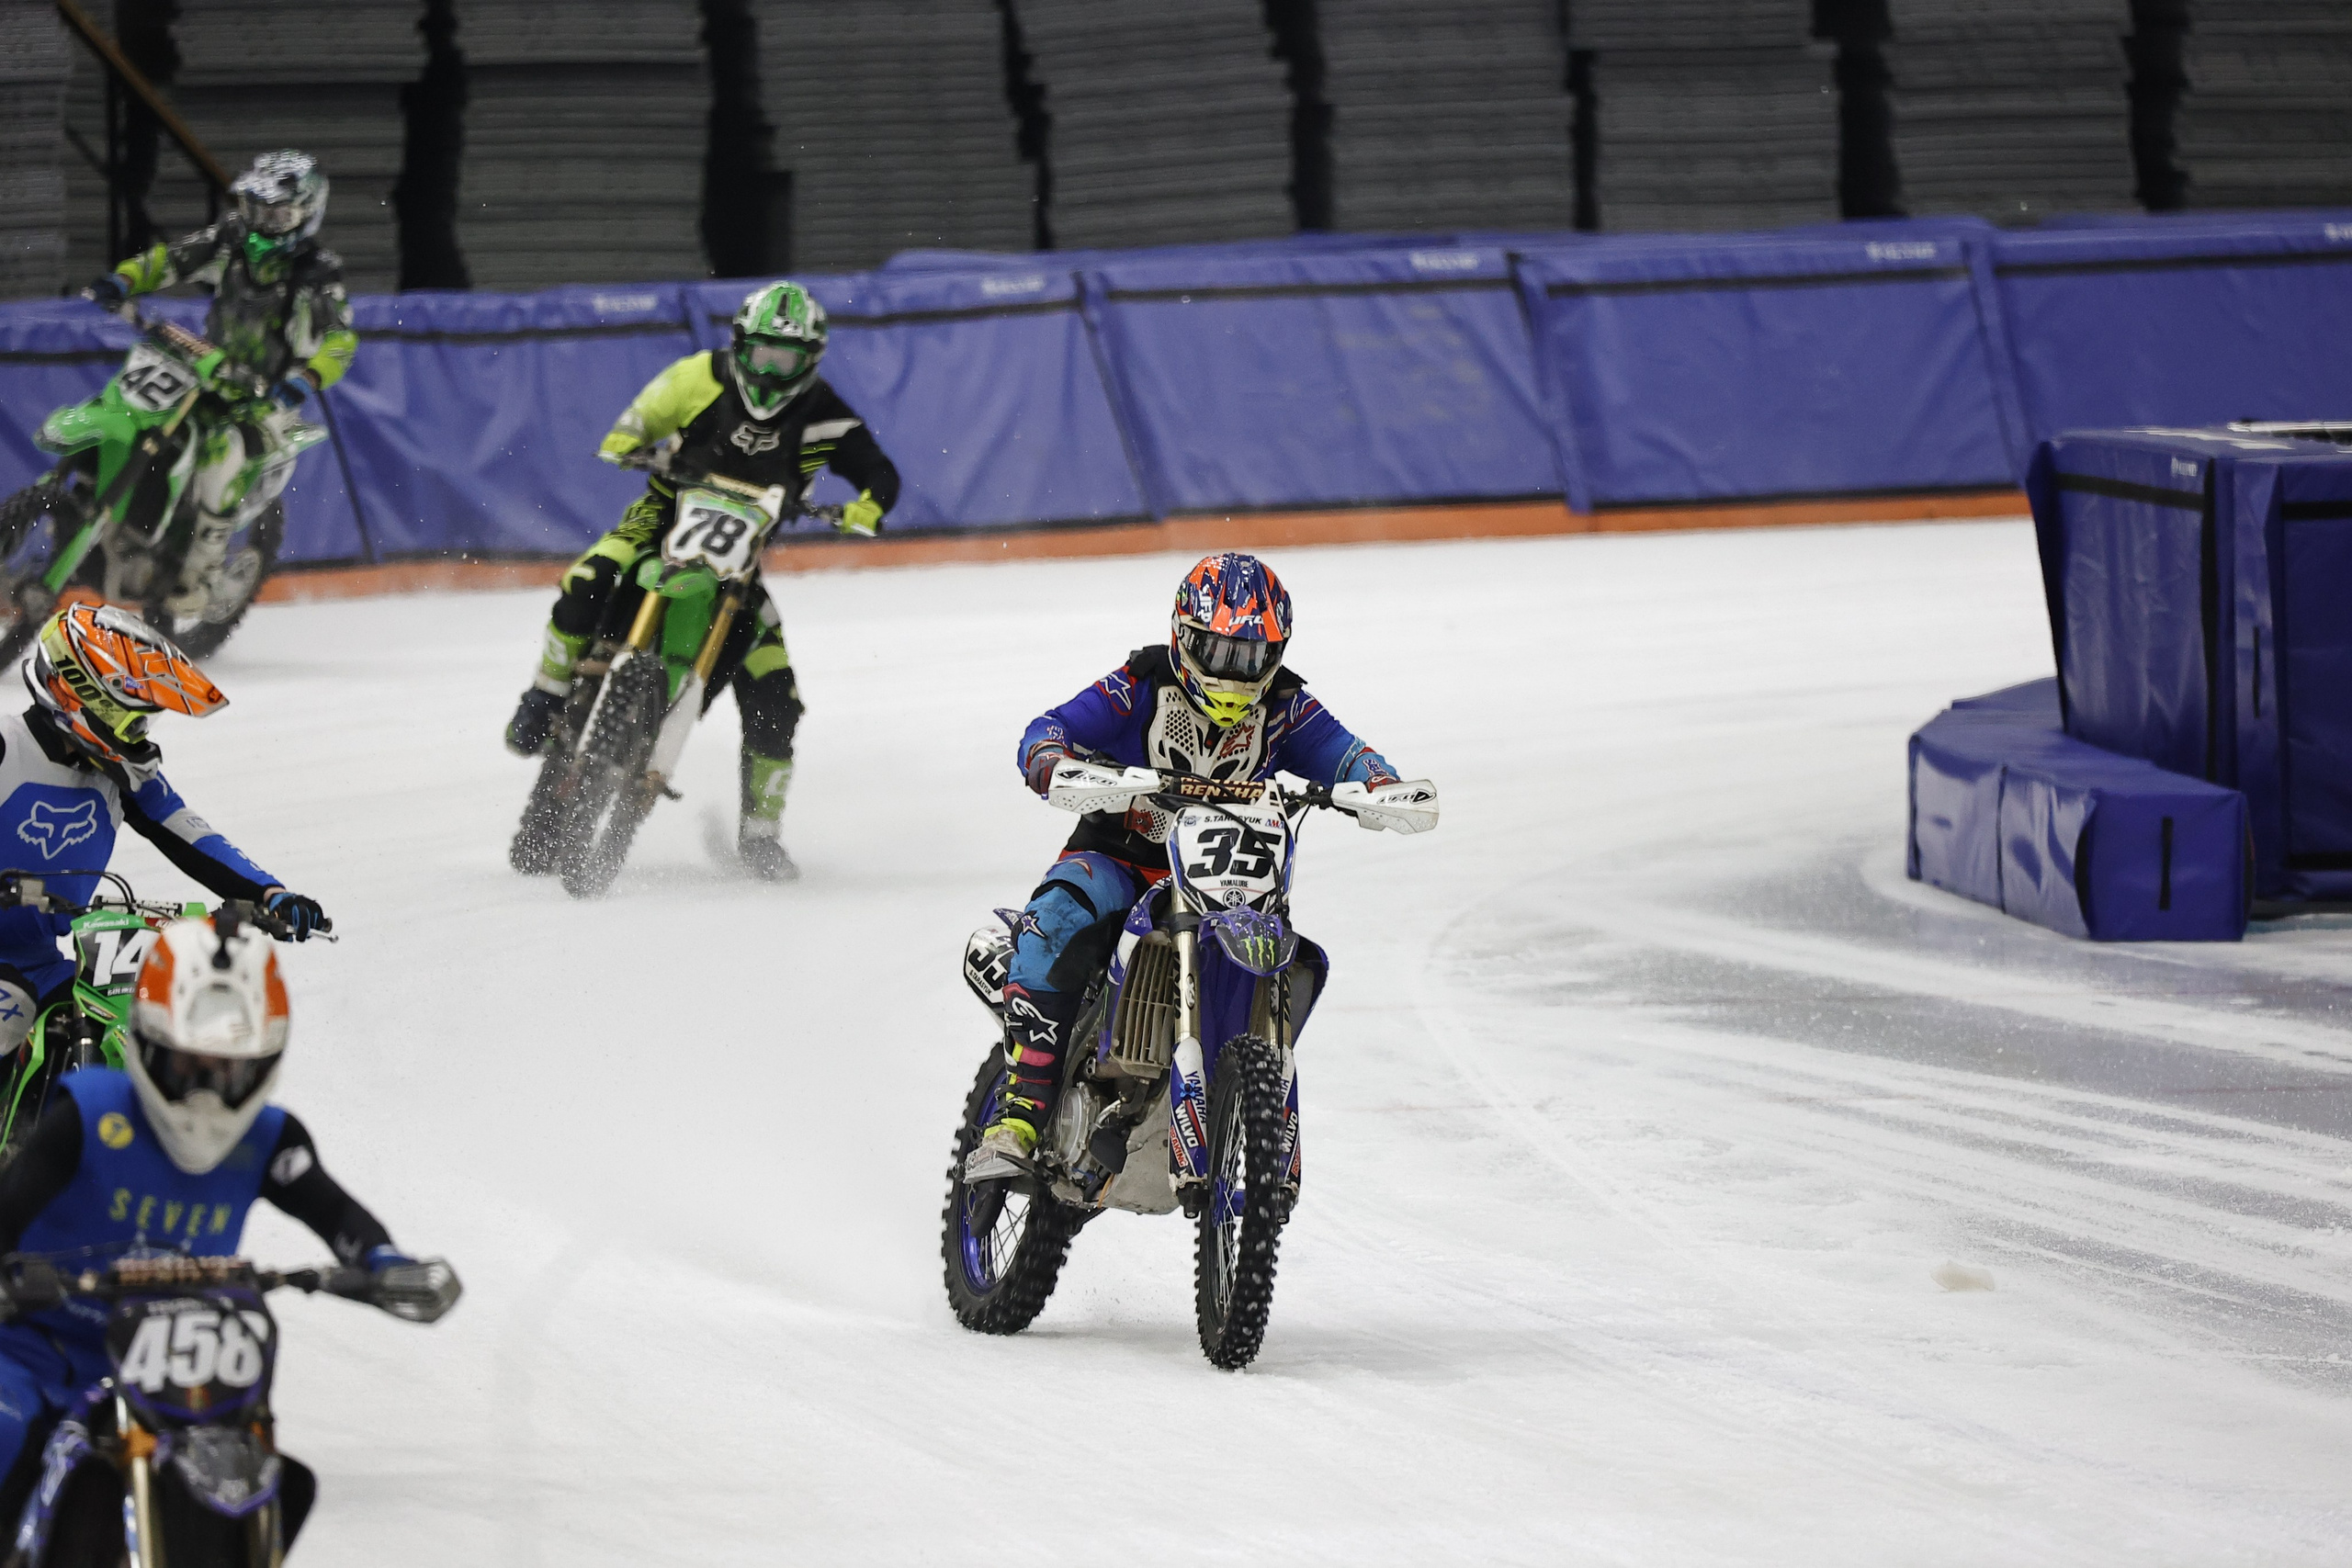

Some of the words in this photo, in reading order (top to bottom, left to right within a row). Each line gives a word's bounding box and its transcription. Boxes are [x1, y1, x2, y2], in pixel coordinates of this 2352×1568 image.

[121, 365, 184, 408] 42
[675, 507, 748, 558] 78
[55, 655, 113, 708] 100%
[1180, 784, 1265, 800] RENHA
[1265, 818, 1285, 829] AMA
[1187, 828, 1283, 879] 35
[1220, 879, 1249, 888] YAMALUBE
[83, 919, 130, 929] Kawasaki
[968, 969, 993, 997] S.TARASYUK
[1184, 1070, 1207, 1124] YAMAHA
[1174, 1103, 1200, 1148] WILVO
[1281, 1111, 1298, 1154] WILVO
[108, 1188, 232, 1237] SEVEN
[120, 1310, 269, 1393] 458
